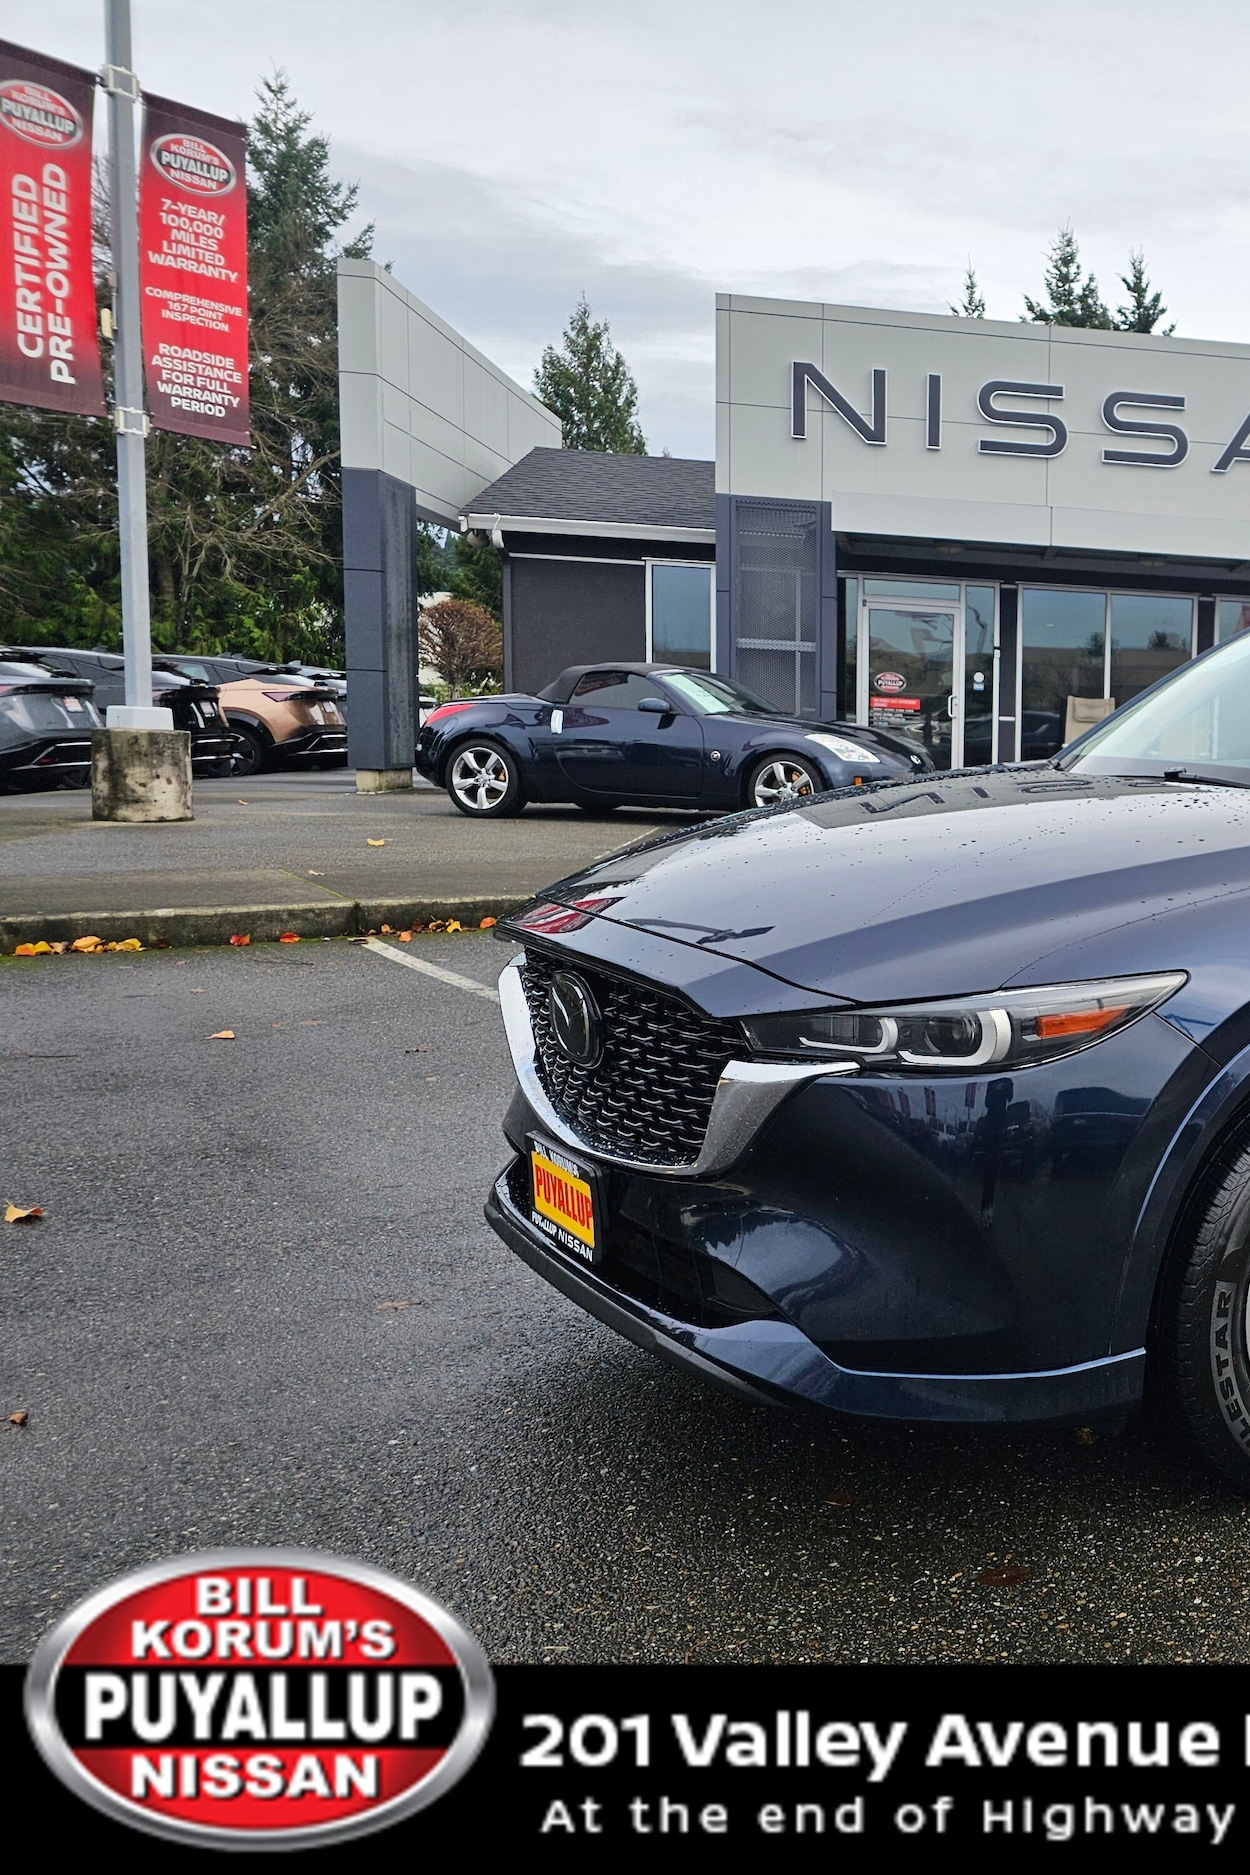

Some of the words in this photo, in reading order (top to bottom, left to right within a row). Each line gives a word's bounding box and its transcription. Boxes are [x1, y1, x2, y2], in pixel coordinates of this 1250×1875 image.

[24, 86, 51, 102] BILL
[1, 100, 75, 134] PUYALLUP
[11, 117, 63, 142] NISSAN
[170, 143, 220, 165] KORUM'S
[183, 139, 206, 153] BILL
[161, 150, 228, 183] PUYALLUP
[170, 169, 217, 190] NISSAN
[159, 212, 224, 239] 100,000
[161, 198, 225, 226] 7-YEAR/
[162, 240, 225, 266] LIMITED
[171, 228, 218, 251] MILES
[12, 174, 44, 358] CERTIFIED
[43, 162, 76, 384] PRE-OWNED
[148, 250, 238, 283] WARRANTY
[145, 286, 242, 317] COMPREHENSIVE
[167, 301, 188, 312] 167
[190, 305, 223, 321] POINT
[162, 309, 229, 332] INSPECTION
[151, 355, 242, 383] ASSISTANCE
[159, 343, 235, 370] ROADSIDE
[157, 381, 240, 408] WARRANTY
[162, 369, 195, 386] FOR
[197, 376, 231, 394] FULL
[171, 396, 226, 418] PERIOD
[535, 1163, 592, 1232] PUYALLUP
[558, 1228, 594, 1262] NISSAN
